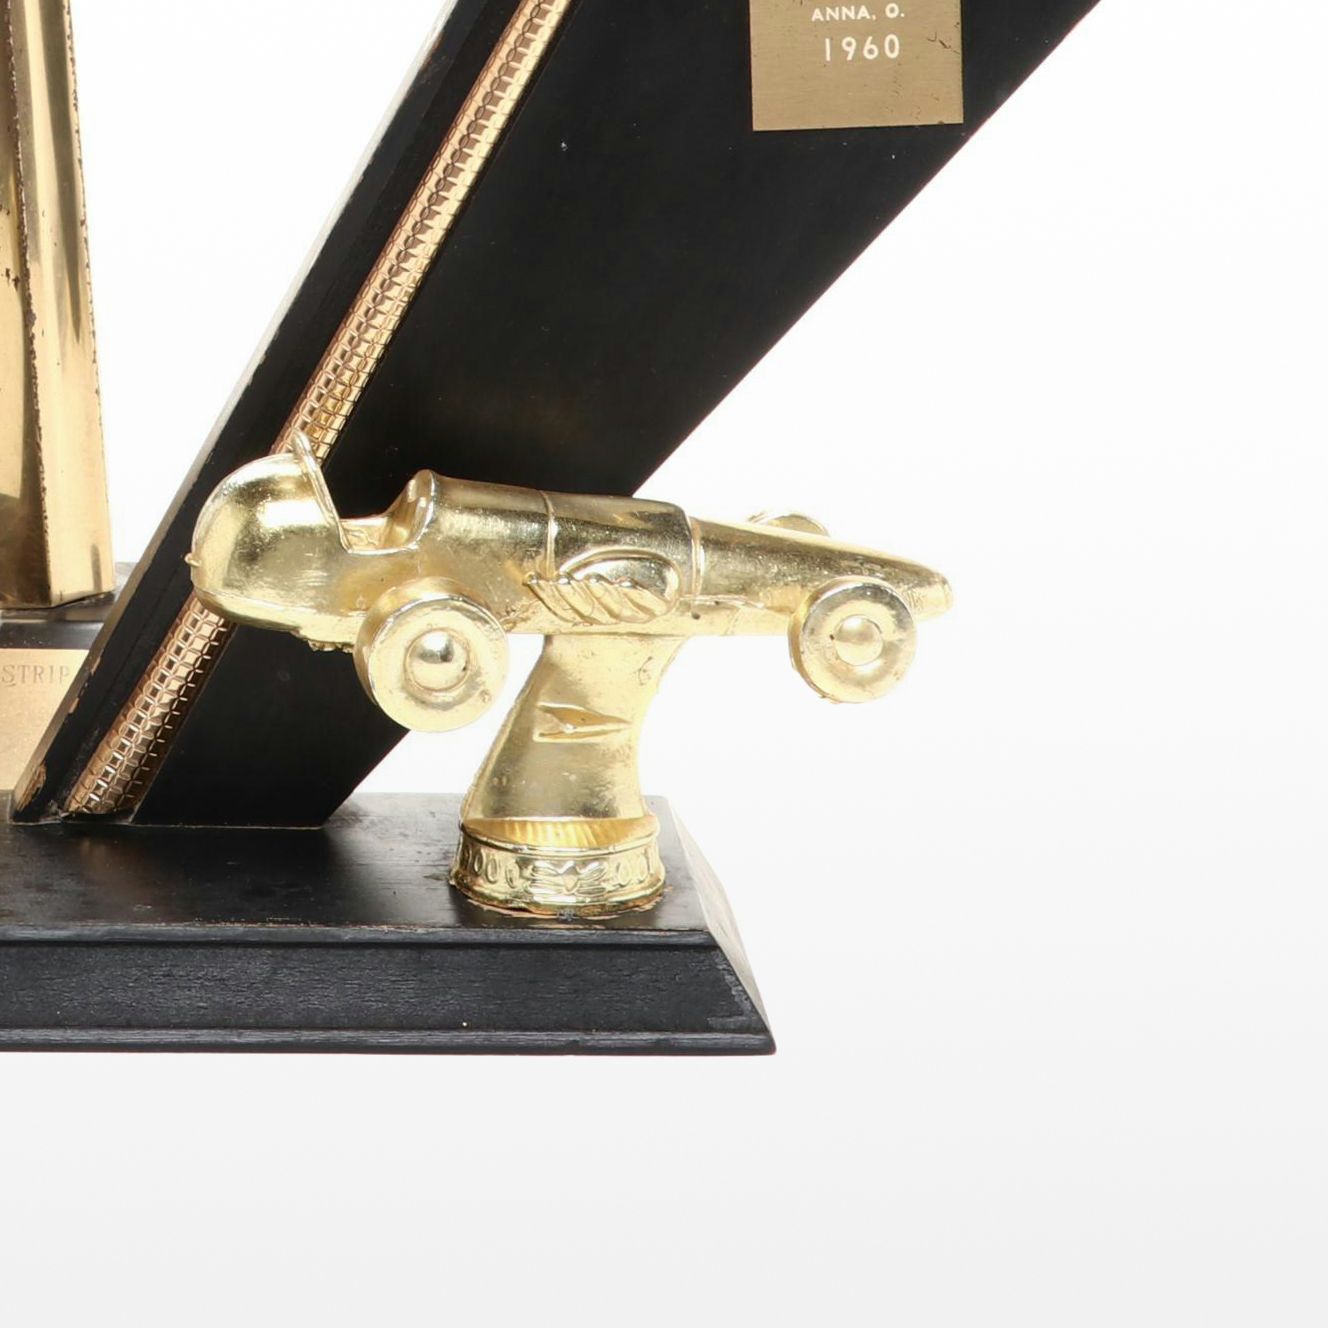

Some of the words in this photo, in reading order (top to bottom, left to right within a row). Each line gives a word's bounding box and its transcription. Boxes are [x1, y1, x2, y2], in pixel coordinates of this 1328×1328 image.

[885, 2, 905, 18] O.
[825, 34, 900, 62] 1960
[1, 663, 71, 685] STRIP
